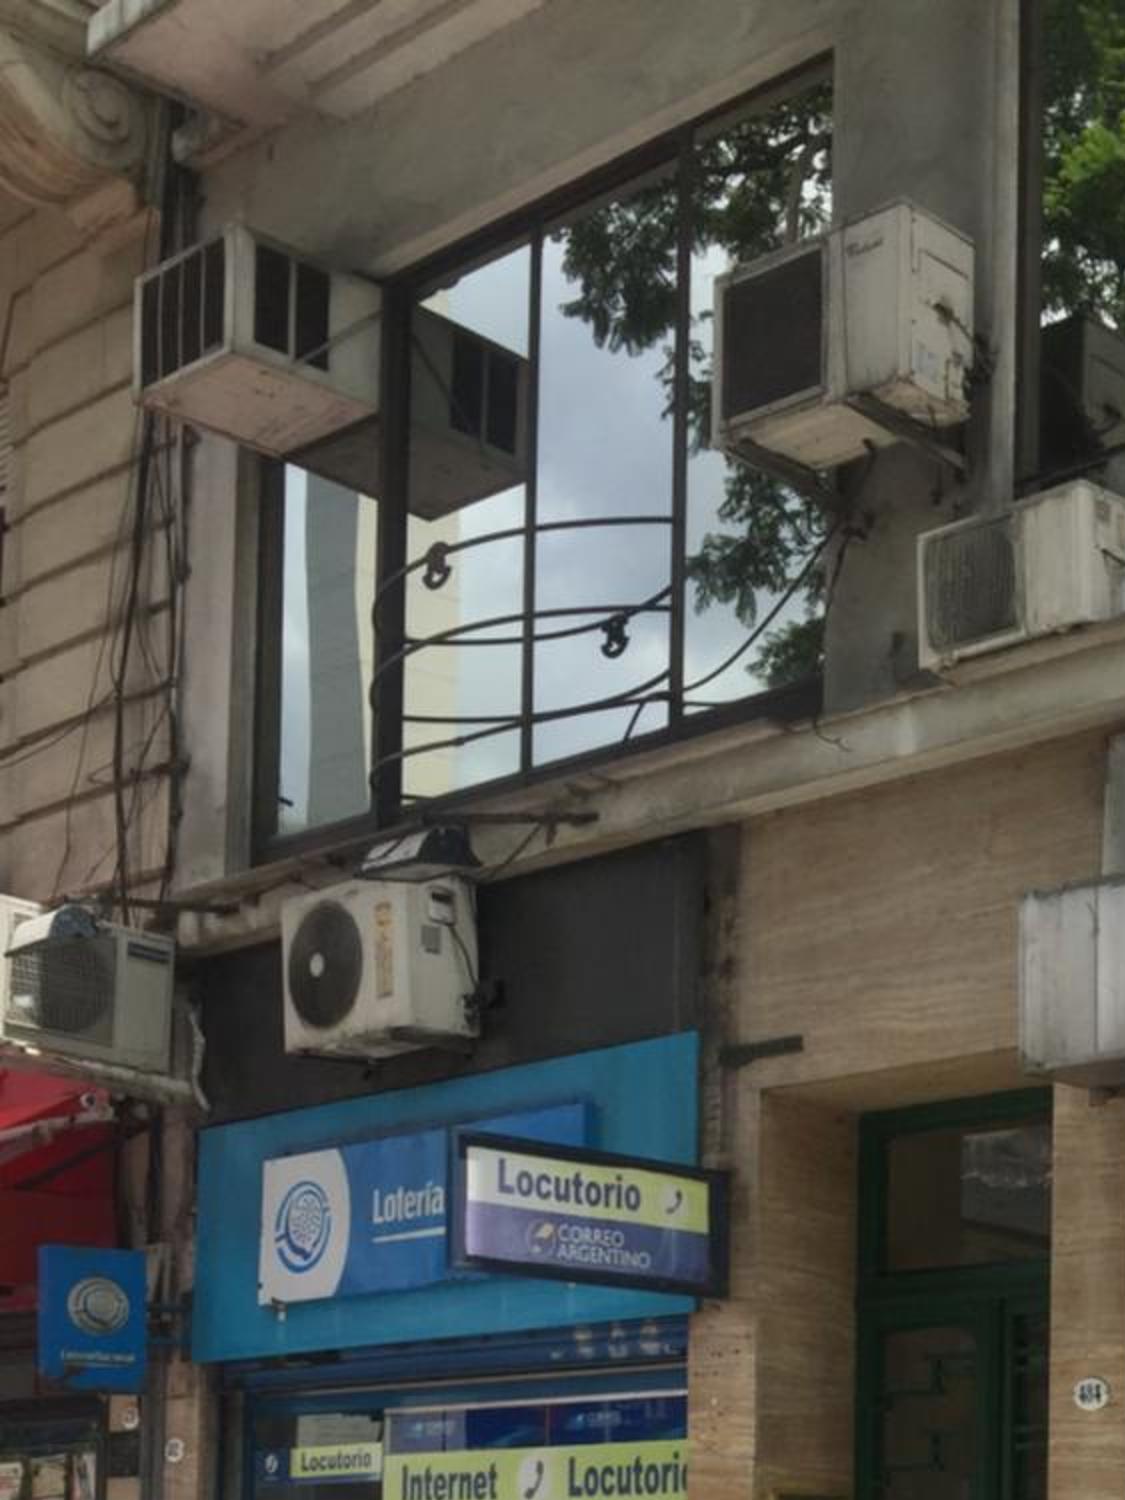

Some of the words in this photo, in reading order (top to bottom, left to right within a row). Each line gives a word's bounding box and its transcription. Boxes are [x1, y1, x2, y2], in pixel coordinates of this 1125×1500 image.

[497, 1157, 642, 1212] Locutorio
[372, 1182, 446, 1226] Lotería
[557, 1223, 625, 1248] CORREO
[556, 1241, 651, 1269] ARGENTINO
[301, 1449, 372, 1474] Locutorio
